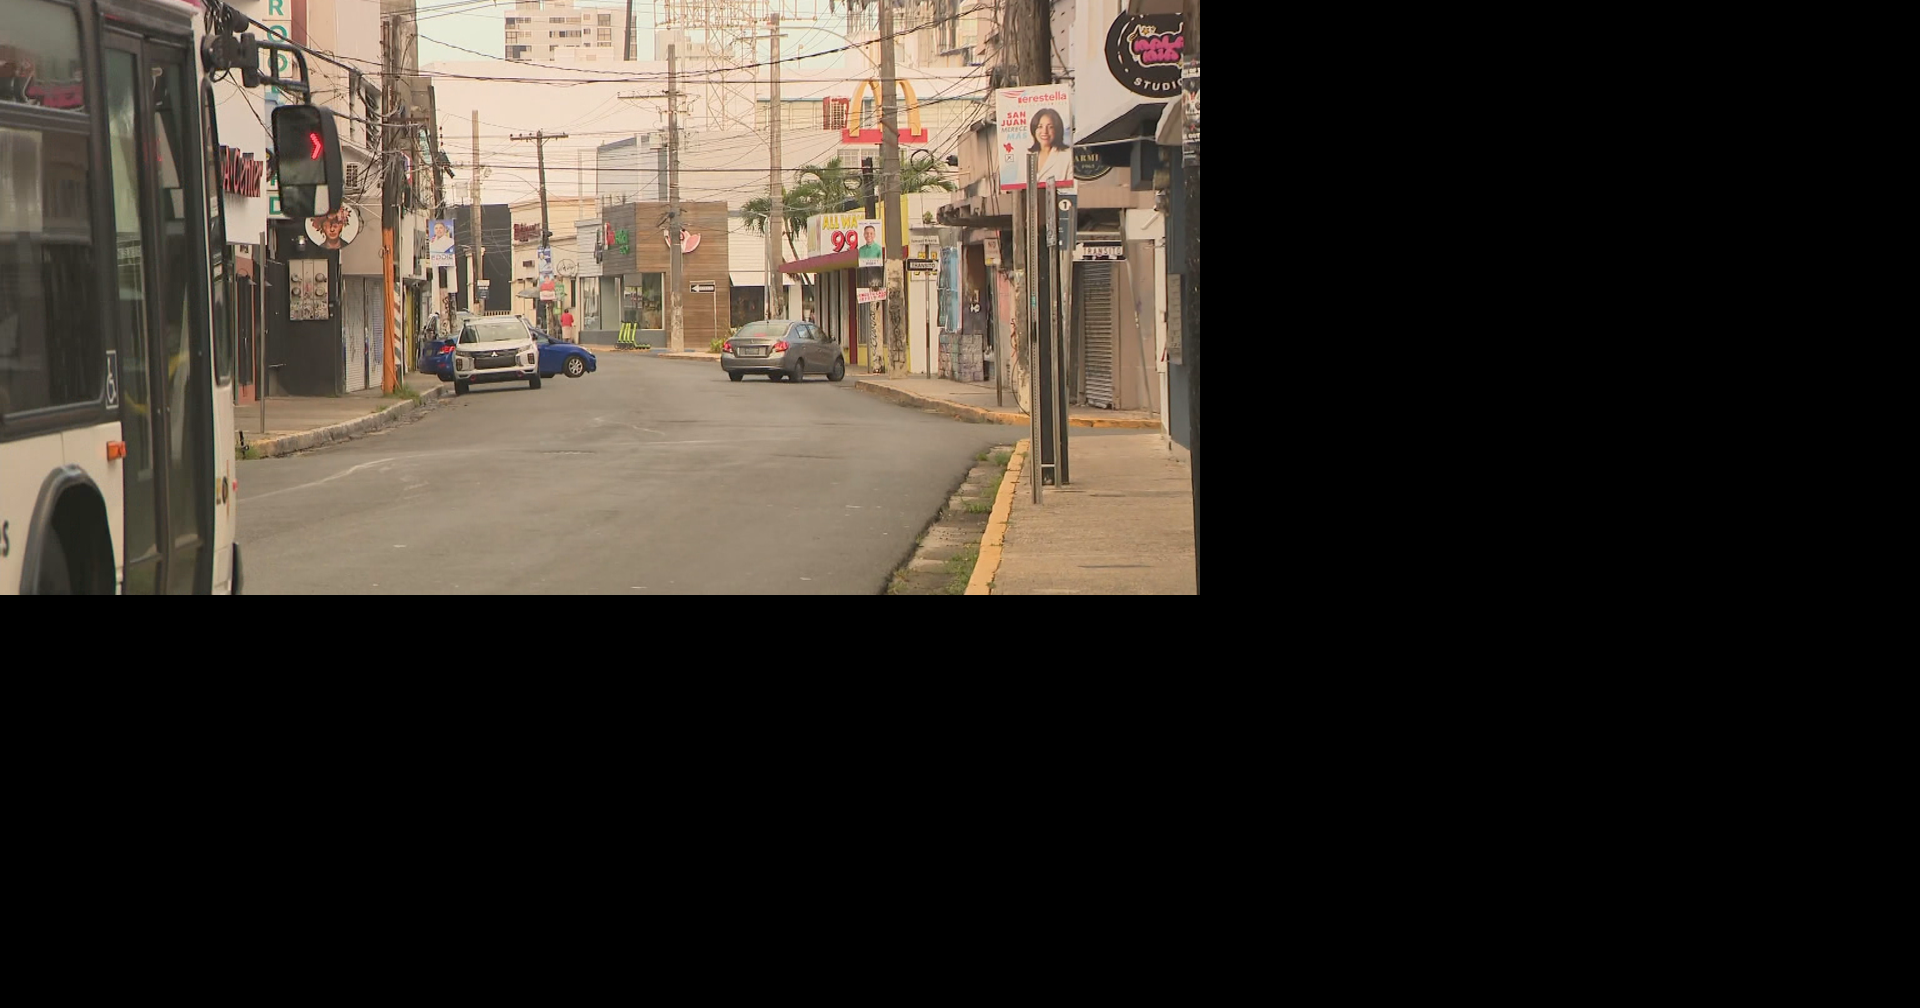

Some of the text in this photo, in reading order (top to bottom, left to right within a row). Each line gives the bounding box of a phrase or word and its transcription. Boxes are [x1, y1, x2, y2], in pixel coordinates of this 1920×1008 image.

[1007, 111, 1026, 119] SAN
[1001, 119, 1027, 127] JUAN
[233, 148, 264, 197] Center
[822, 216, 840, 230] ALL
[831, 230, 858, 252] 99
